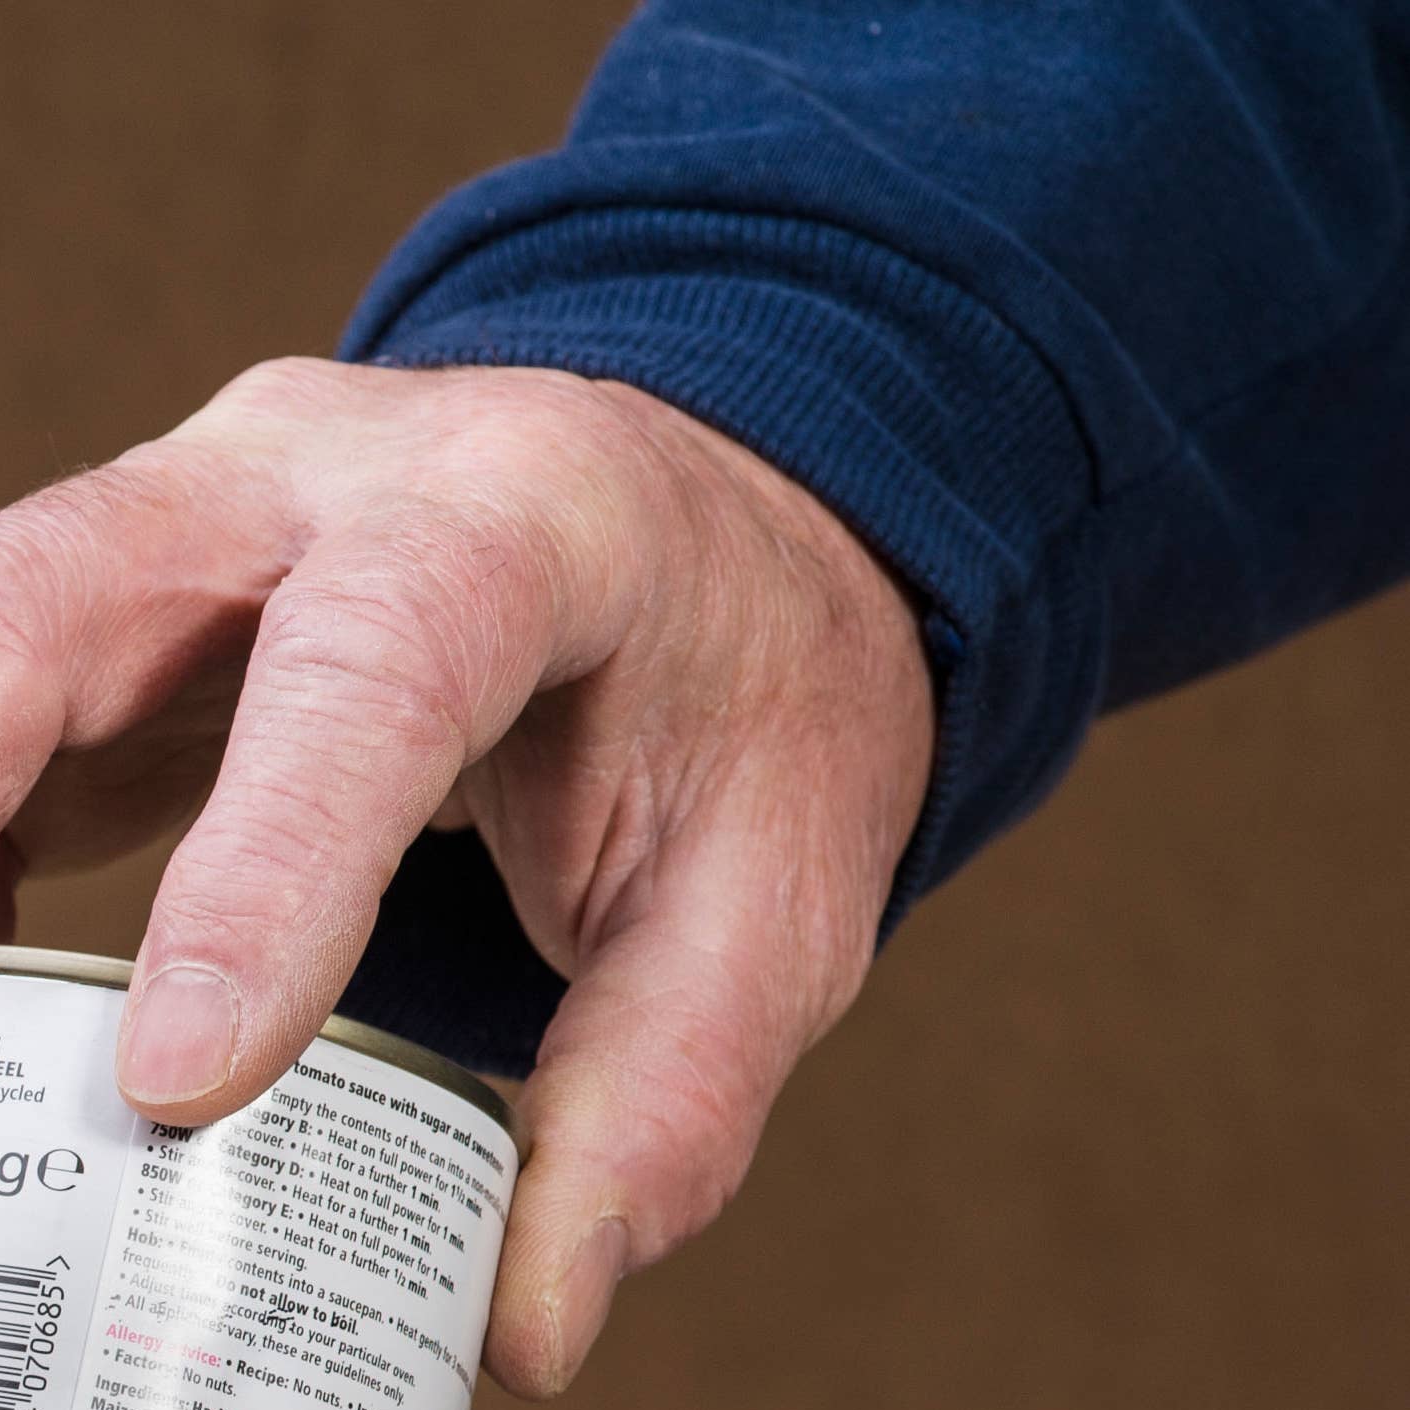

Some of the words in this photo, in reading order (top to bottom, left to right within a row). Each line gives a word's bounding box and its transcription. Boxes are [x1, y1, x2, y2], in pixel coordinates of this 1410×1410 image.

[294, 1062, 345, 1091] tomato
[348, 1080, 386, 1104] sauce
[390, 1097, 418, 1120] with
[420, 1111, 450, 1136] sugar
[236, 1359, 289, 1391] Recipe:
[293, 1379, 310, 1396] No
[314, 1389, 343, 1410] nuts.
